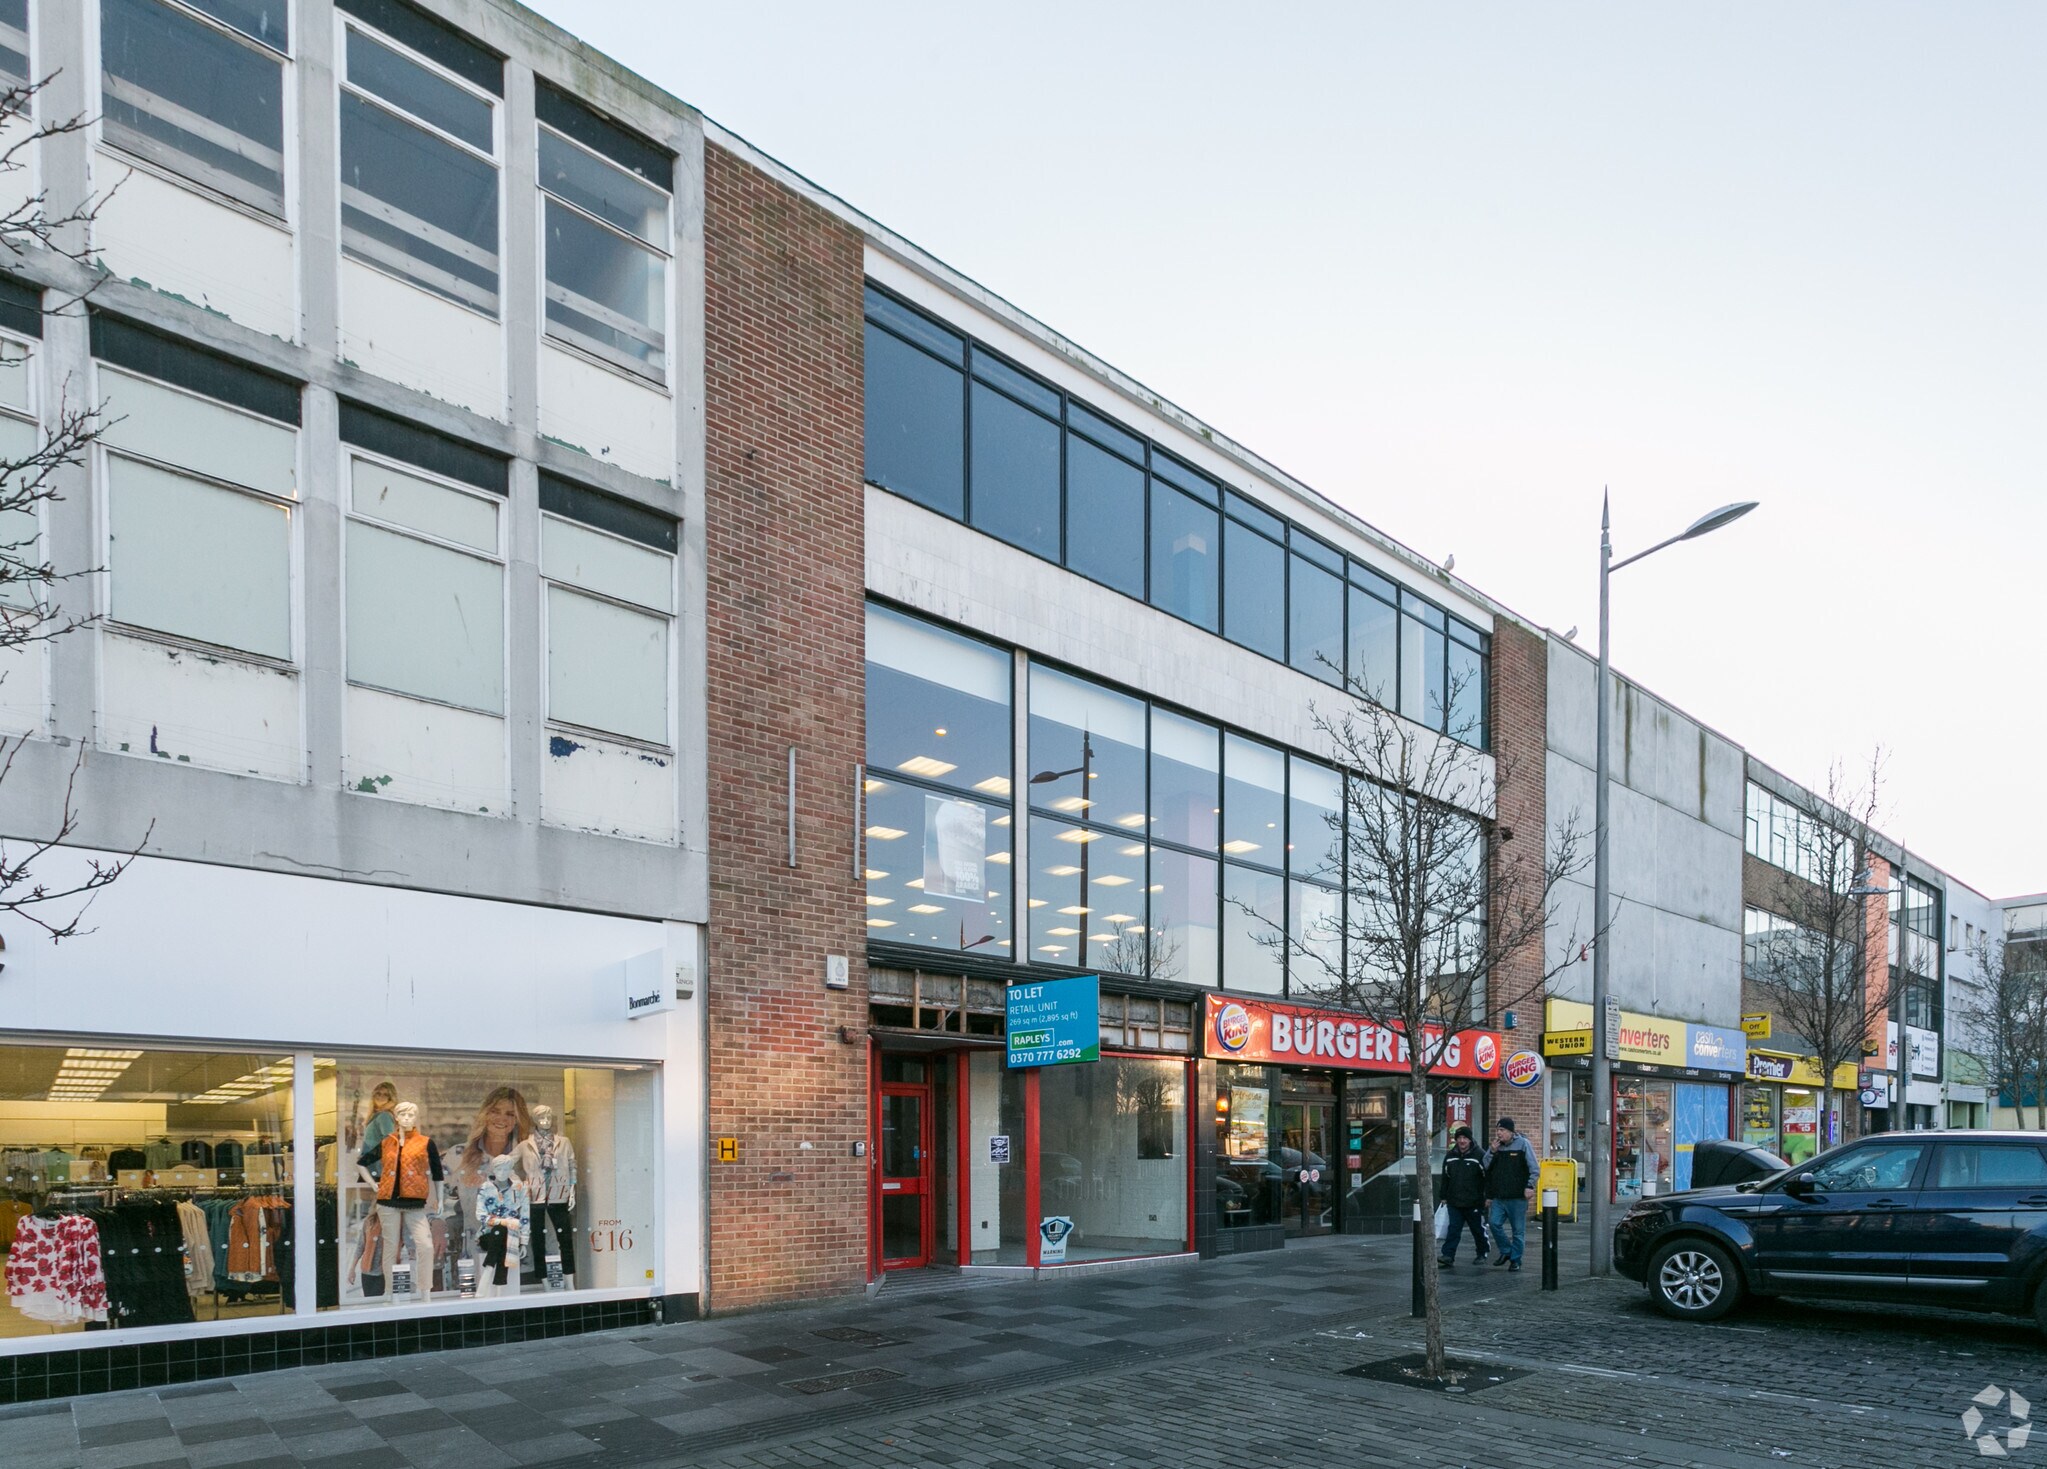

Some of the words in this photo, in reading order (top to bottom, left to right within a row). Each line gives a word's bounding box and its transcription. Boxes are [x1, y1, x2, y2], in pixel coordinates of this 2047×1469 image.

[629, 989, 661, 1010] Bonmarché
[1009, 989, 1022, 1000] TO
[1024, 986, 1044, 999] LET
[1010, 1004, 1036, 1015] RETAIL
[1038, 1001, 1058, 1012] UNIT
[1009, 1018, 1022, 1026] 269
[1023, 1018, 1030, 1026] sq
[1039, 1014, 1060, 1024] (2,895
[1061, 1014, 1069, 1022] sq
[1070, 1011, 1078, 1020] ft)
[1014, 1033, 1051, 1046] RAPLEYS
[1056, 1039, 1074, 1047] .com
[1223, 1023, 1248, 1042] KING
[1271, 1013, 1393, 1064] BURGER
[1546, 1036, 1585, 1045] WESTERN
[1619, 1027, 1671, 1050] nverters
[1695, 1031, 1715, 1045] cash
[1010, 1052, 1034, 1064] 0370
[1036, 1050, 1055, 1062] 777
[1056, 1048, 1082, 1060] 6292
[1477, 1050, 1496, 1066] KING
[1693, 1043, 1737, 1060] converters
[1507, 1056, 1536, 1071] BURGER
[1753, 1056, 1785, 1077] Premier
[1509, 1064, 1537, 1080] KING
[721, 1140, 735, 1158] H
[598, 1219, 622, 1227] FROM
[589, 1229, 633, 1252] £16
